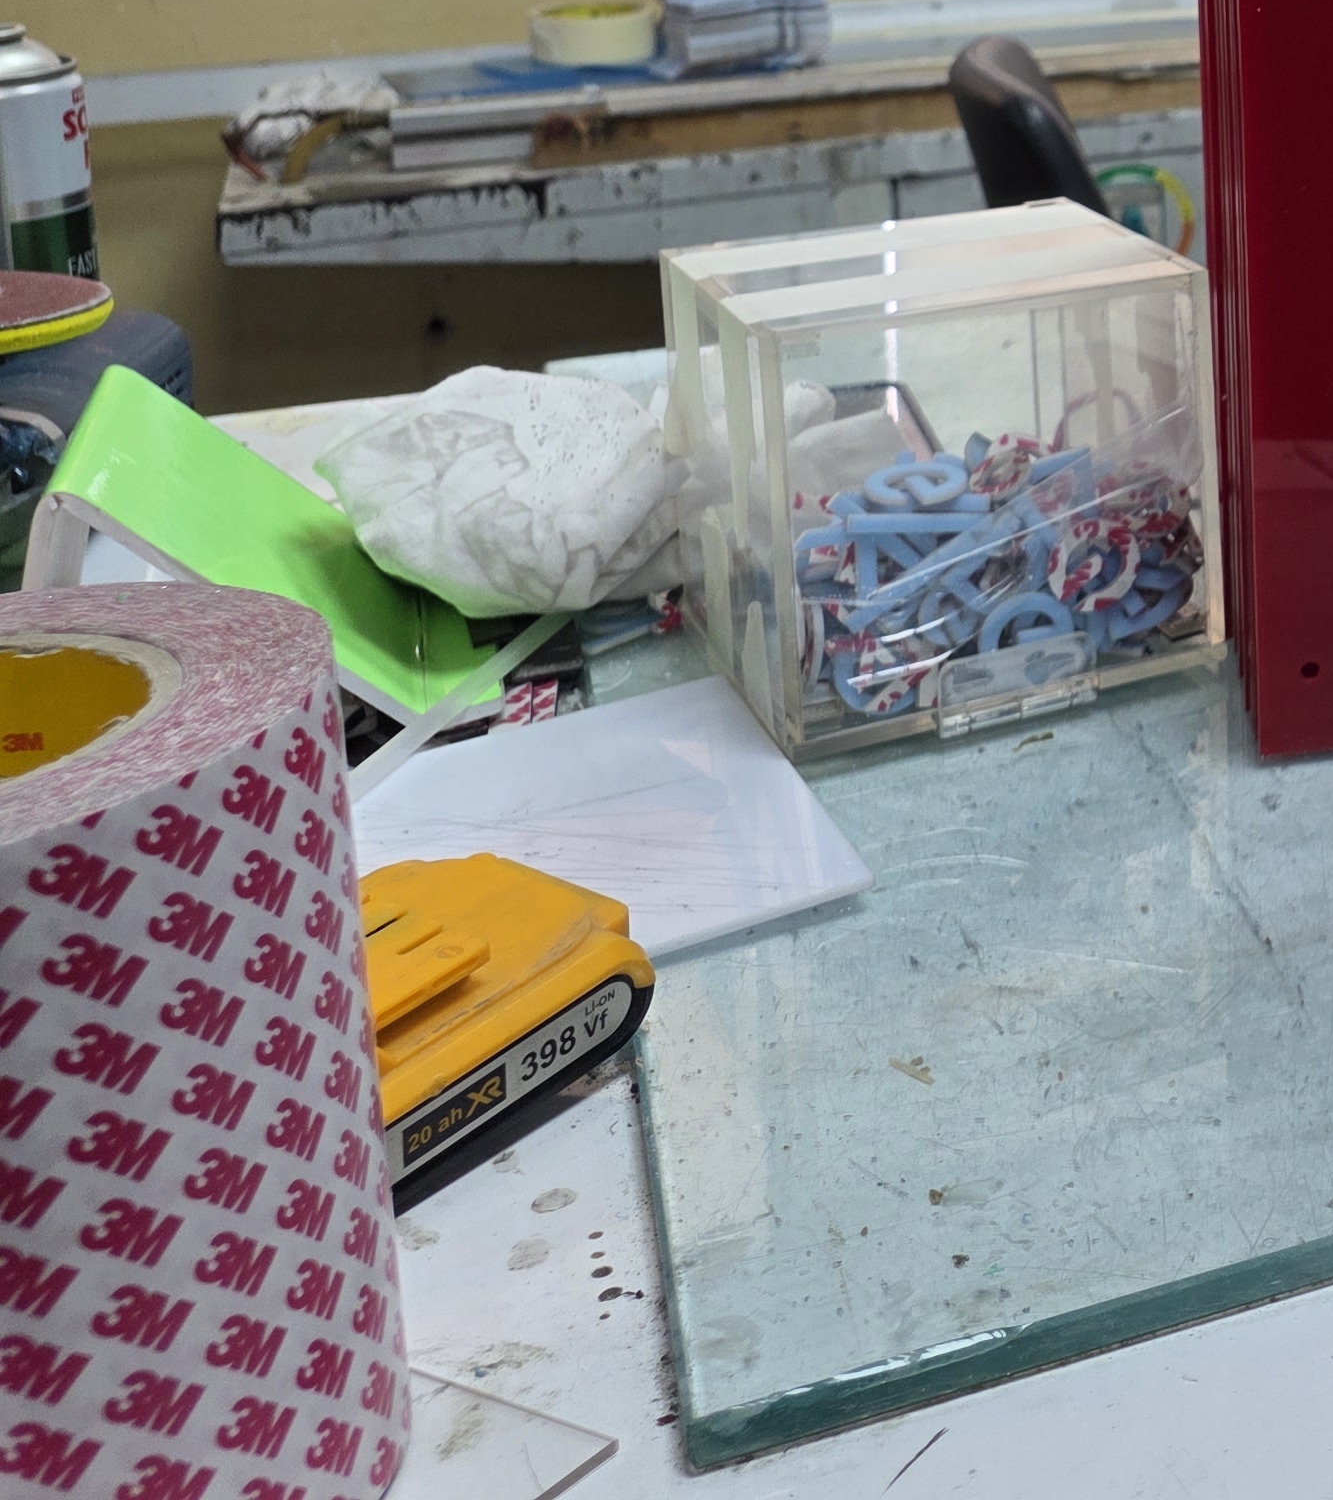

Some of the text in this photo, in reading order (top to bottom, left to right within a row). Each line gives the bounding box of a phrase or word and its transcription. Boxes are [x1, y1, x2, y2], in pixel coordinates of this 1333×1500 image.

[2, 732, 44, 753] 3M
[284, 726, 326, 793] 3M
[222, 764, 286, 834] 3M
[135, 804, 223, 876] 3M
[294, 809, 334, 875] 3M
[27, 844, 136, 918] 3M
[233, 849, 296, 917] 3M
[147, 892, 234, 962] 3M
[304, 891, 343, 955] 3M
[41, 934, 148, 1007] 3M
[243, 933, 306, 1000] 3M
[159, 978, 245, 1046] 3M
[314, 971, 352, 1035] 3M
[584, 988, 616, 1017] LI-ON
[53, 1023, 160, 1094] 3M
[254, 1017, 317, 1080] 3M
[324, 1051, 361, 1112] 3M
[406, 1007, 609, 1156] 20 ah XR 398 Vf
[172, 1064, 256, 1131] 3M
[265, 1098, 326, 1161] 3M
[66, 1110, 172, 1182] 3M
[333, 1129, 370, 1189] 3M
[183, 1148, 267, 1213] 3M
[275, 1179, 336, 1241] 3M
[79, 1198, 183, 1267] 3M
[194, 1231, 277, 1297] 3M
[343, 1207, 379, 1264] 3M
[90, 1285, 195, 1352] 3M
[285, 1259, 345, 1321] 3M
[352, 1285, 387, 1343] 3M
[0, 1334, 92, 1405] 3M
[205, 1314, 287, 1378] 3M
[294, 1338, 354, 1398] 3M
[102, 1370, 206, 1437] 3M
[361, 1361, 396, 1419] 3M
[0, 1421, 102, 1491] 3M
[215, 1395, 297, 1459] 3M
[304, 1417, 363, 1477] 3M
[114, 1454, 217, 1500] 3M
